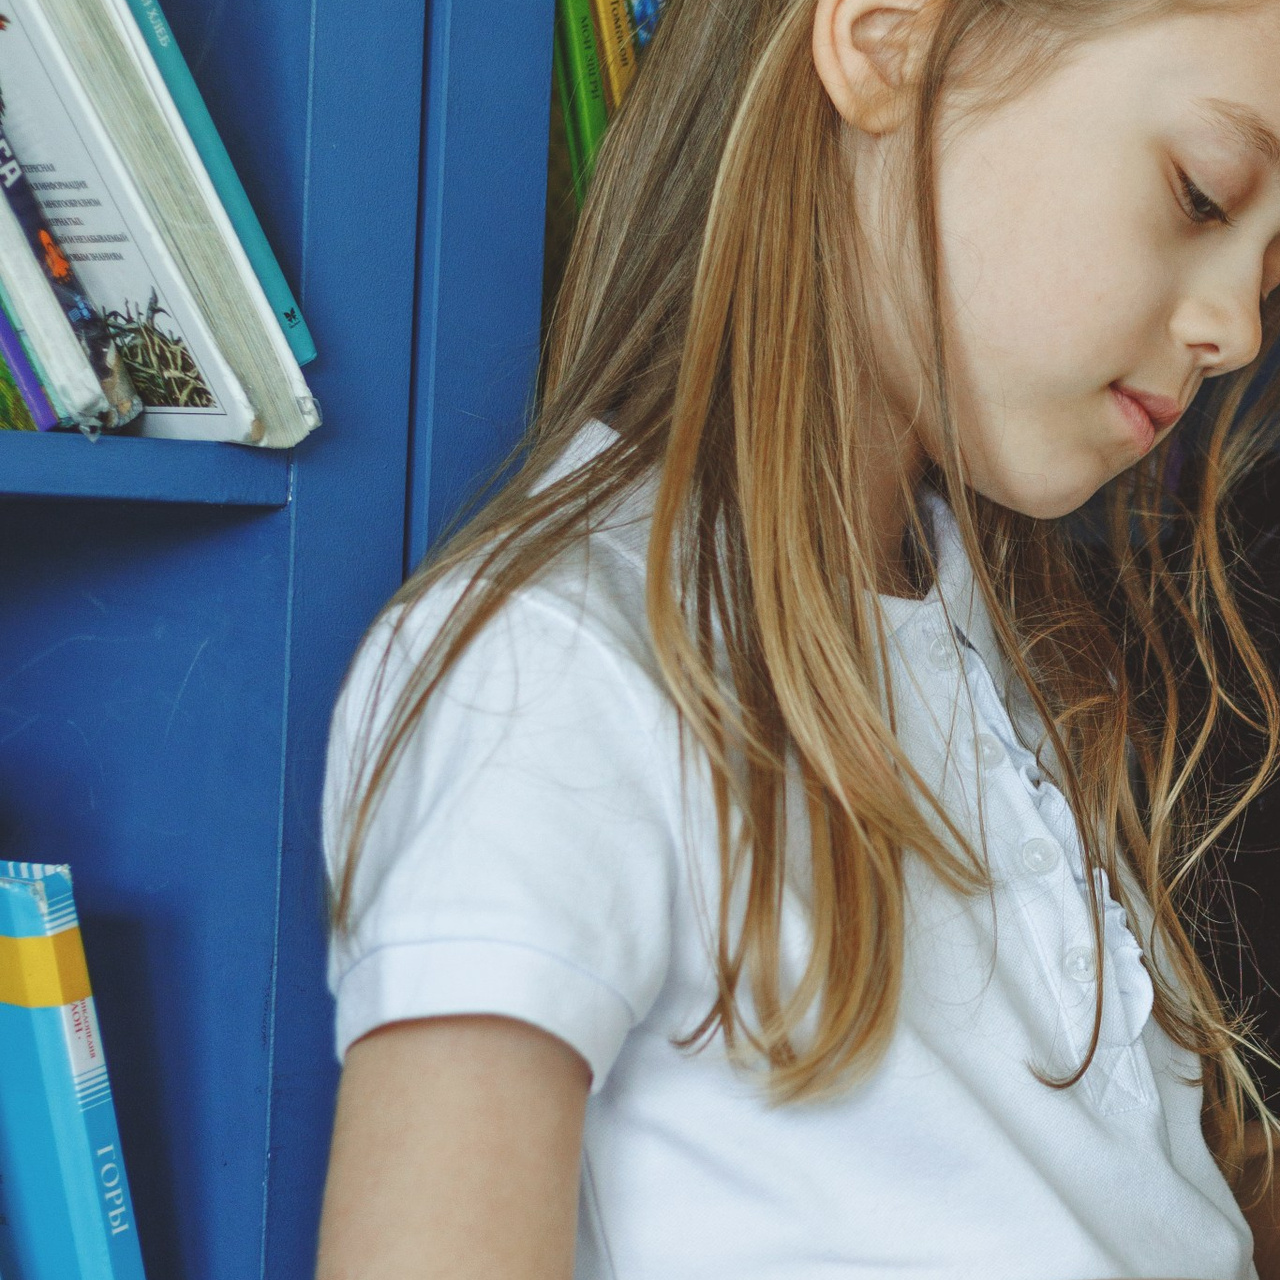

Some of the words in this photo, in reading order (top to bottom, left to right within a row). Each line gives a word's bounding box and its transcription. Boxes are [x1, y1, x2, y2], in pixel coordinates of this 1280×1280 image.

[146, 5, 172, 48] ХЛЕБ
[22, 163, 56, 174] ТЕРЕСНАЯ
[38, 180, 89, 192] ИНФОРМАЦИЯ
[43, 198, 102, 209] МНОГООБРАЗНОМ
[72, 231, 130, 243] НЕЗАБЫВАЕМЫЙ
[80, 998, 97, 1059] ИКЛОПЕДИЯ
[97, 1142, 129, 1237] ГОРЫ
